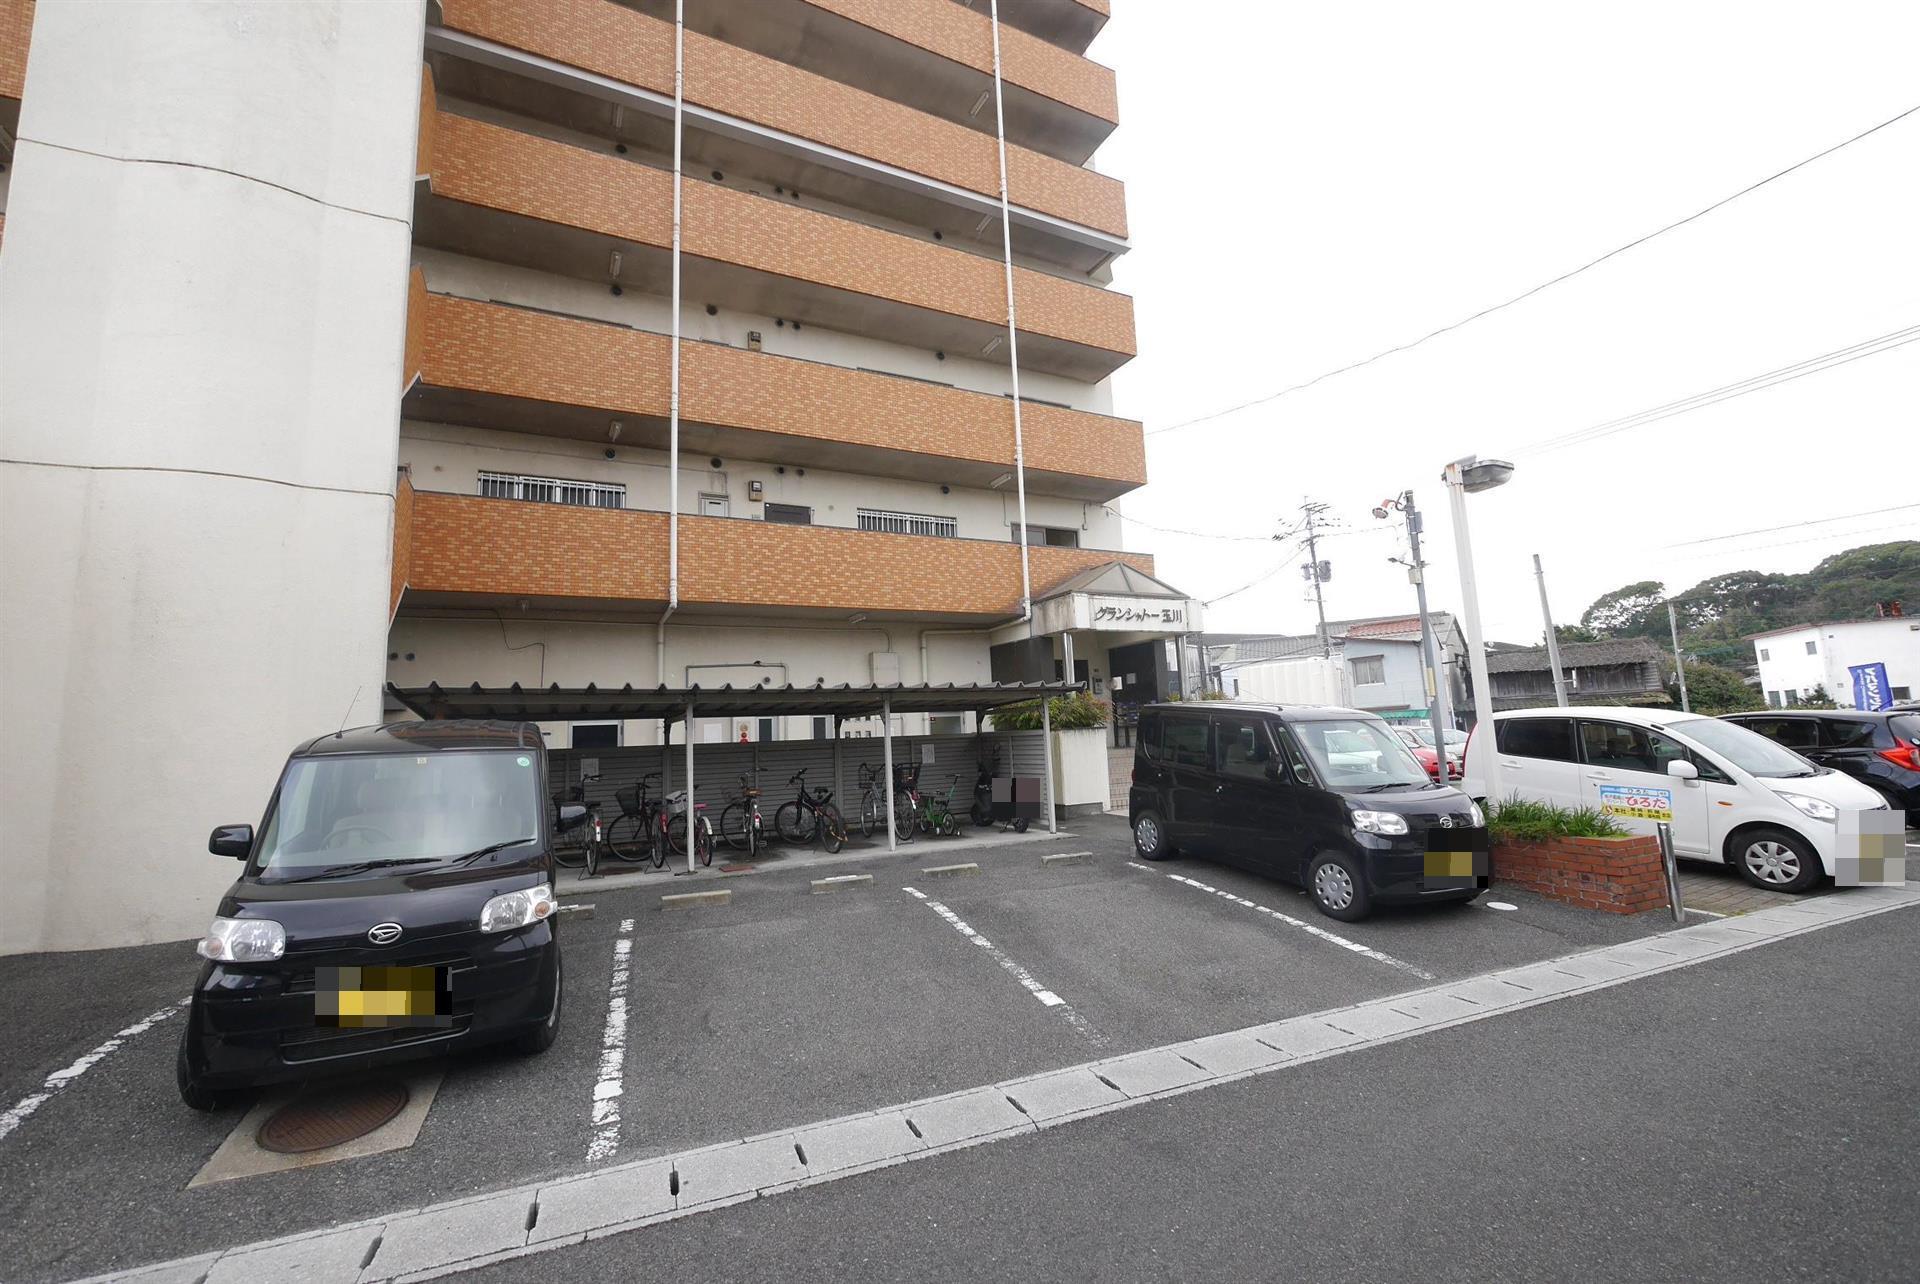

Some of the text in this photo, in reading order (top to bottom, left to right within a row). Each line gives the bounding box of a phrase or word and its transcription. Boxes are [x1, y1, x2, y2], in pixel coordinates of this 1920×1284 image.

[1094, 606, 1182, 624] グランシャトー玉川
[1625, 796, 1666, 809] ひろた
